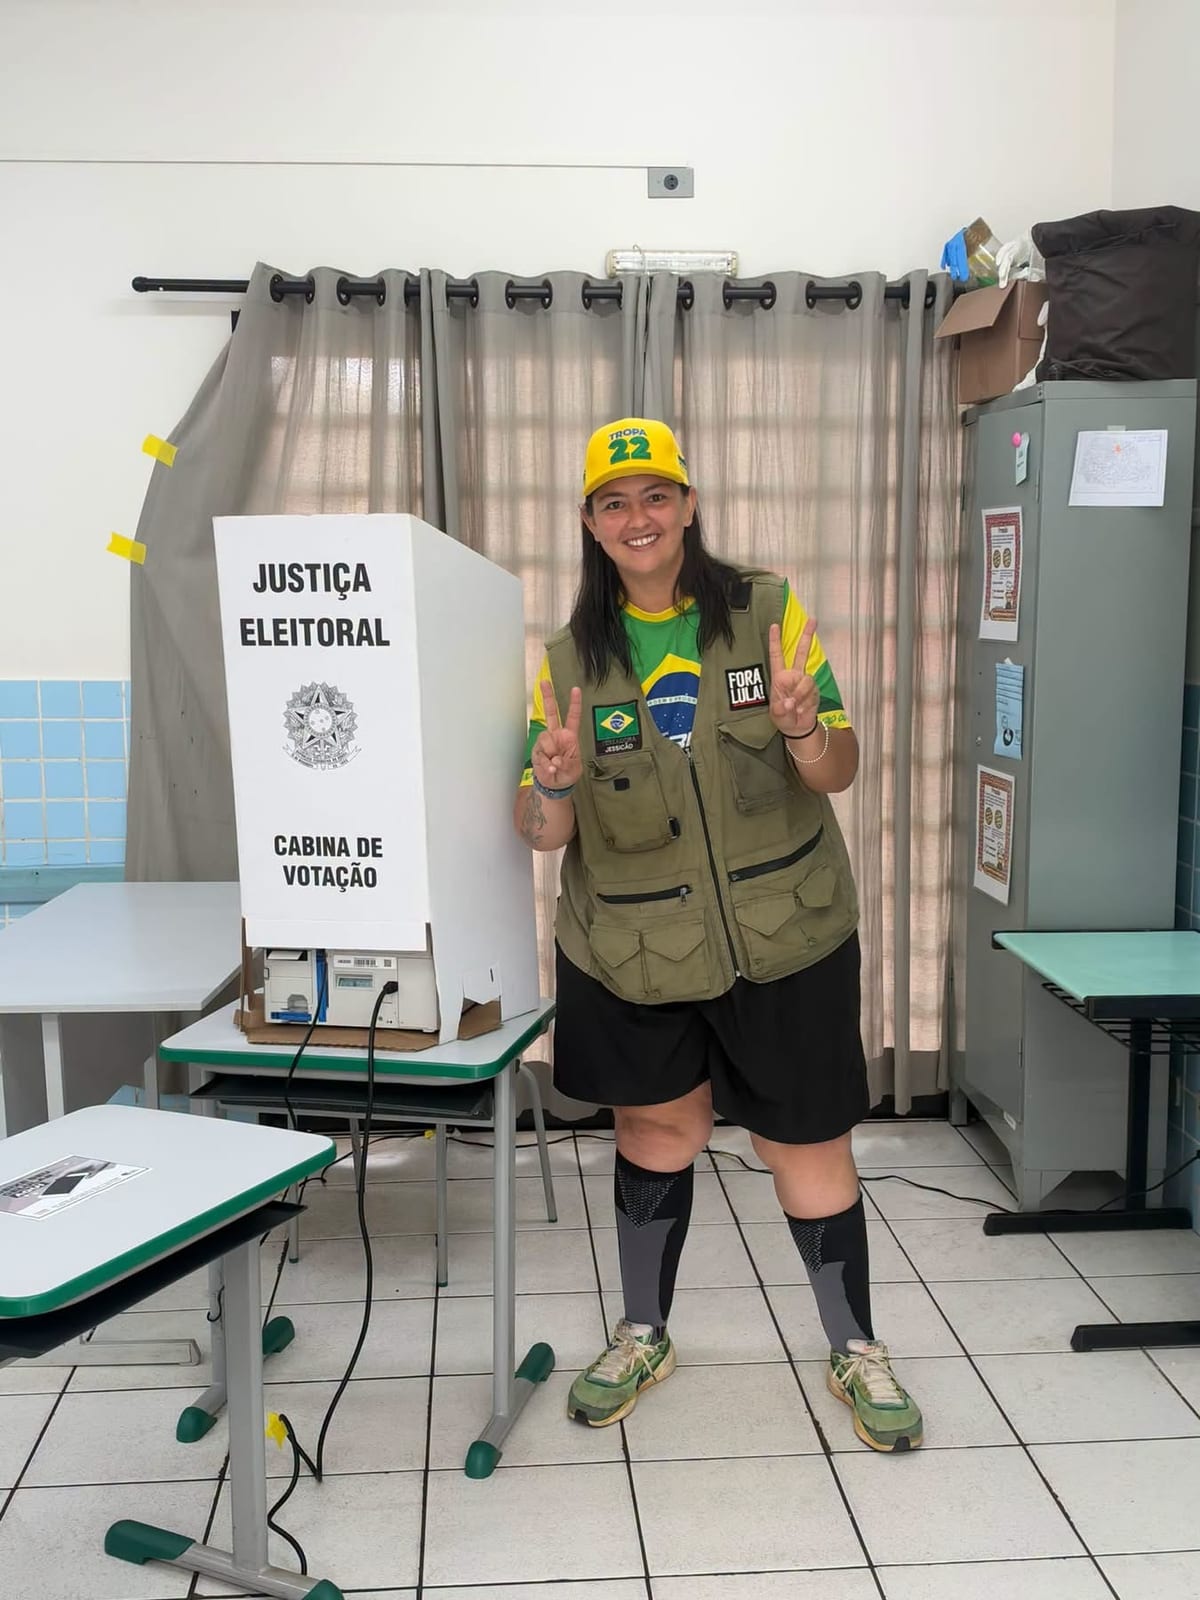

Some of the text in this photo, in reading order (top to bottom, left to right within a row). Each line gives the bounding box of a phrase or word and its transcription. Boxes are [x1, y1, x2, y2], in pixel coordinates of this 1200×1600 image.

[609, 428, 647, 440] TROPA
[608, 436, 652, 465] 22
[252, 563, 372, 600] JUSTIÇA
[240, 617, 391, 647] ELEITORAL
[728, 668, 762, 688] FORA
[730, 683, 766, 705] LULA!
[274, 835, 383, 858] CABINA DE
[283, 862, 378, 892] VOTAÇÃO
